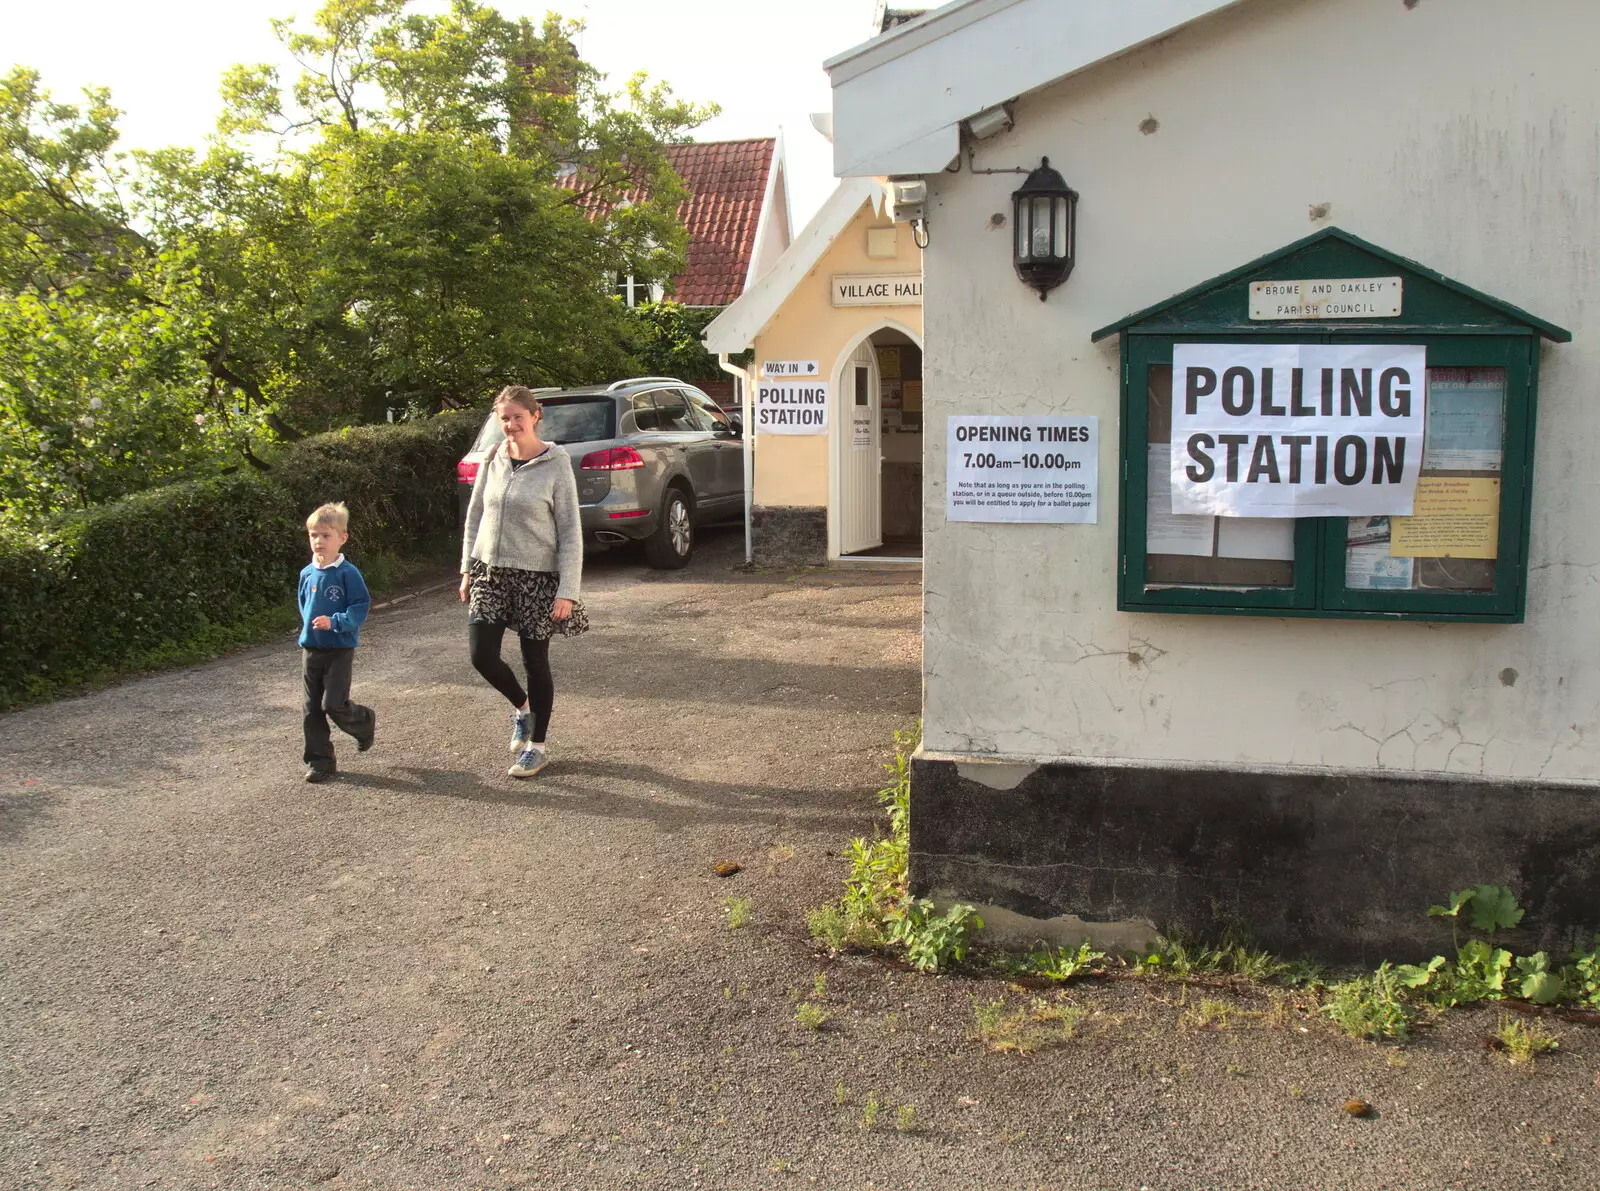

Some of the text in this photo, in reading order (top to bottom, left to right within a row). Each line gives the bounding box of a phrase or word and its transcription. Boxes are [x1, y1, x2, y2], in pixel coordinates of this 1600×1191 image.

[840, 284, 889, 298] VILLAGE
[1266, 283, 1383, 295] BROME AND OAKLEY
[1277, 304, 1375, 314] PARISH COUNCIL
[766, 363, 798, 373] WAY IN
[760, 388, 825, 404] POLLING
[1185, 365, 1411, 418] POLLING
[760, 409, 824, 425] STATION
[956, 426, 1089, 442] OPENING TIMES
[1185, 433, 1406, 486] STATION
